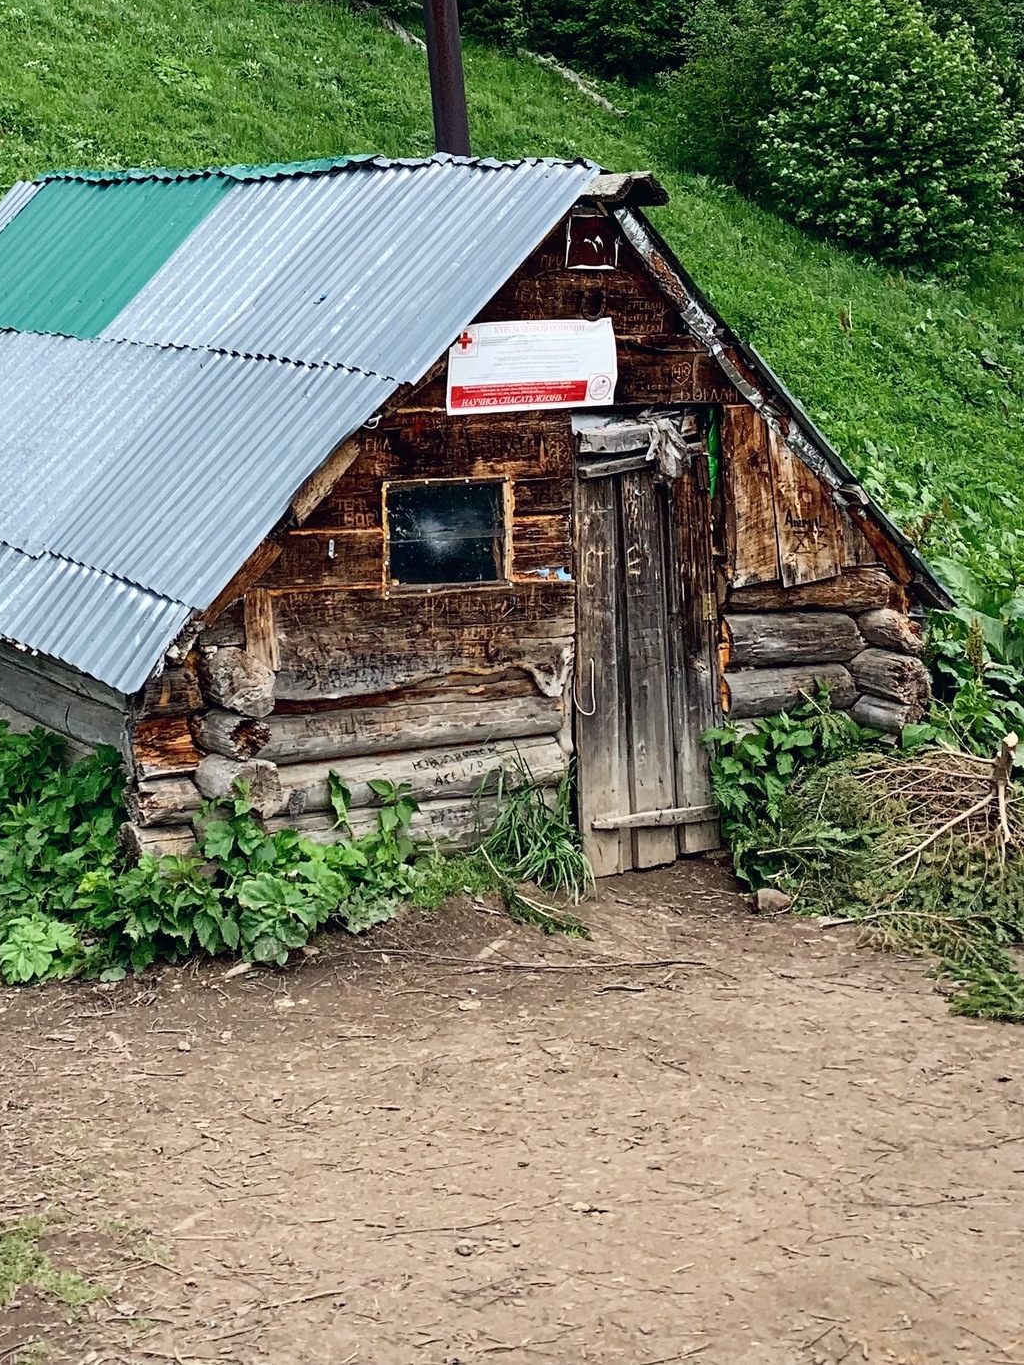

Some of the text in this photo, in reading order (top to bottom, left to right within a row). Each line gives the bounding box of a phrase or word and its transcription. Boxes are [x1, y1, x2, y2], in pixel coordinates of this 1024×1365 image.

[494, 324, 585, 334] КУРСЫ ПЕРВОЙ ПОМОЩИ
[461, 398, 498, 407] НАУЧИСЬ
[499, 395, 534, 405] СПАСАТЬ
[534, 394, 562, 403] ЖИЗНЬ
